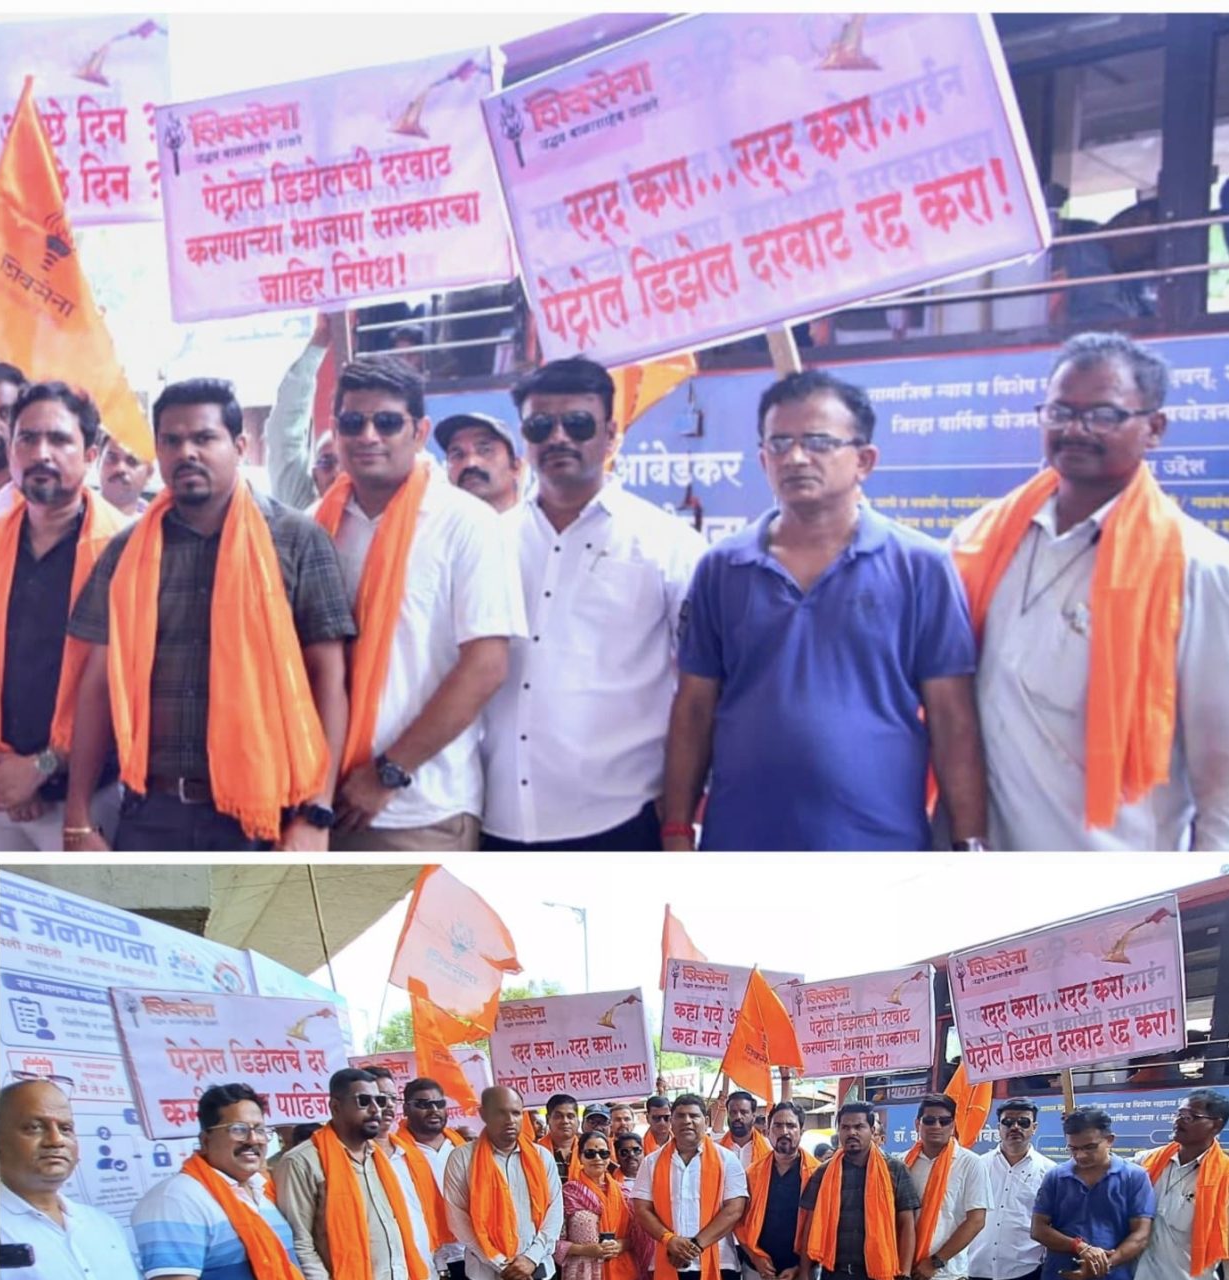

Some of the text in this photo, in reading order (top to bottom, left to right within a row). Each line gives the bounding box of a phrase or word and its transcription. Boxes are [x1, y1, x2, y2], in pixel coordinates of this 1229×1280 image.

[524, 61, 652, 132] शिवसेना
[77, 95, 127, 150] दिन
[188, 101, 299, 147] शिवसेना
[79, 152, 130, 207] दिन
[201, 169, 265, 221] पेट्रोल
[271, 147, 372, 205] डिझेलची
[290, 212, 364, 250] भाजपा
[372, 192, 480, 241] सरकारचा
[259, 257, 325, 304] जाहिर
[538, 267, 630, 349] पेट्रोल
[631, 235, 738, 319] डिझेल
[682, 965, 729, 985] शिवसेना
[966, 948, 1027, 977] शिवसेना
[141, 996, 216, 1017] शिवसेना
[674, 1000, 724, 1023] कहा गये
[804, 986, 850, 1005] शिवसेना
[672, 1025, 722, 1048] कहा गये
[810, 1014, 834, 1037] पेट्रोल
[836, 1007, 878, 1032] डिझेलची
[843, 1034, 873, 1050] भाजपा
[876, 1029, 921, 1047] सरकारचा
[165, 1037, 227, 1080] पेट्रोल
[229, 1039, 302, 1076] डिझेलचे
[305, 1049, 329, 1075] दर
[830, 1053, 856, 1073] जाहिर
[965, 1037, 1004, 1073] पेट्रोल
[1007, 1027, 1053, 1065] डिझेल
[531, 1066, 565, 1093] डिझेल
